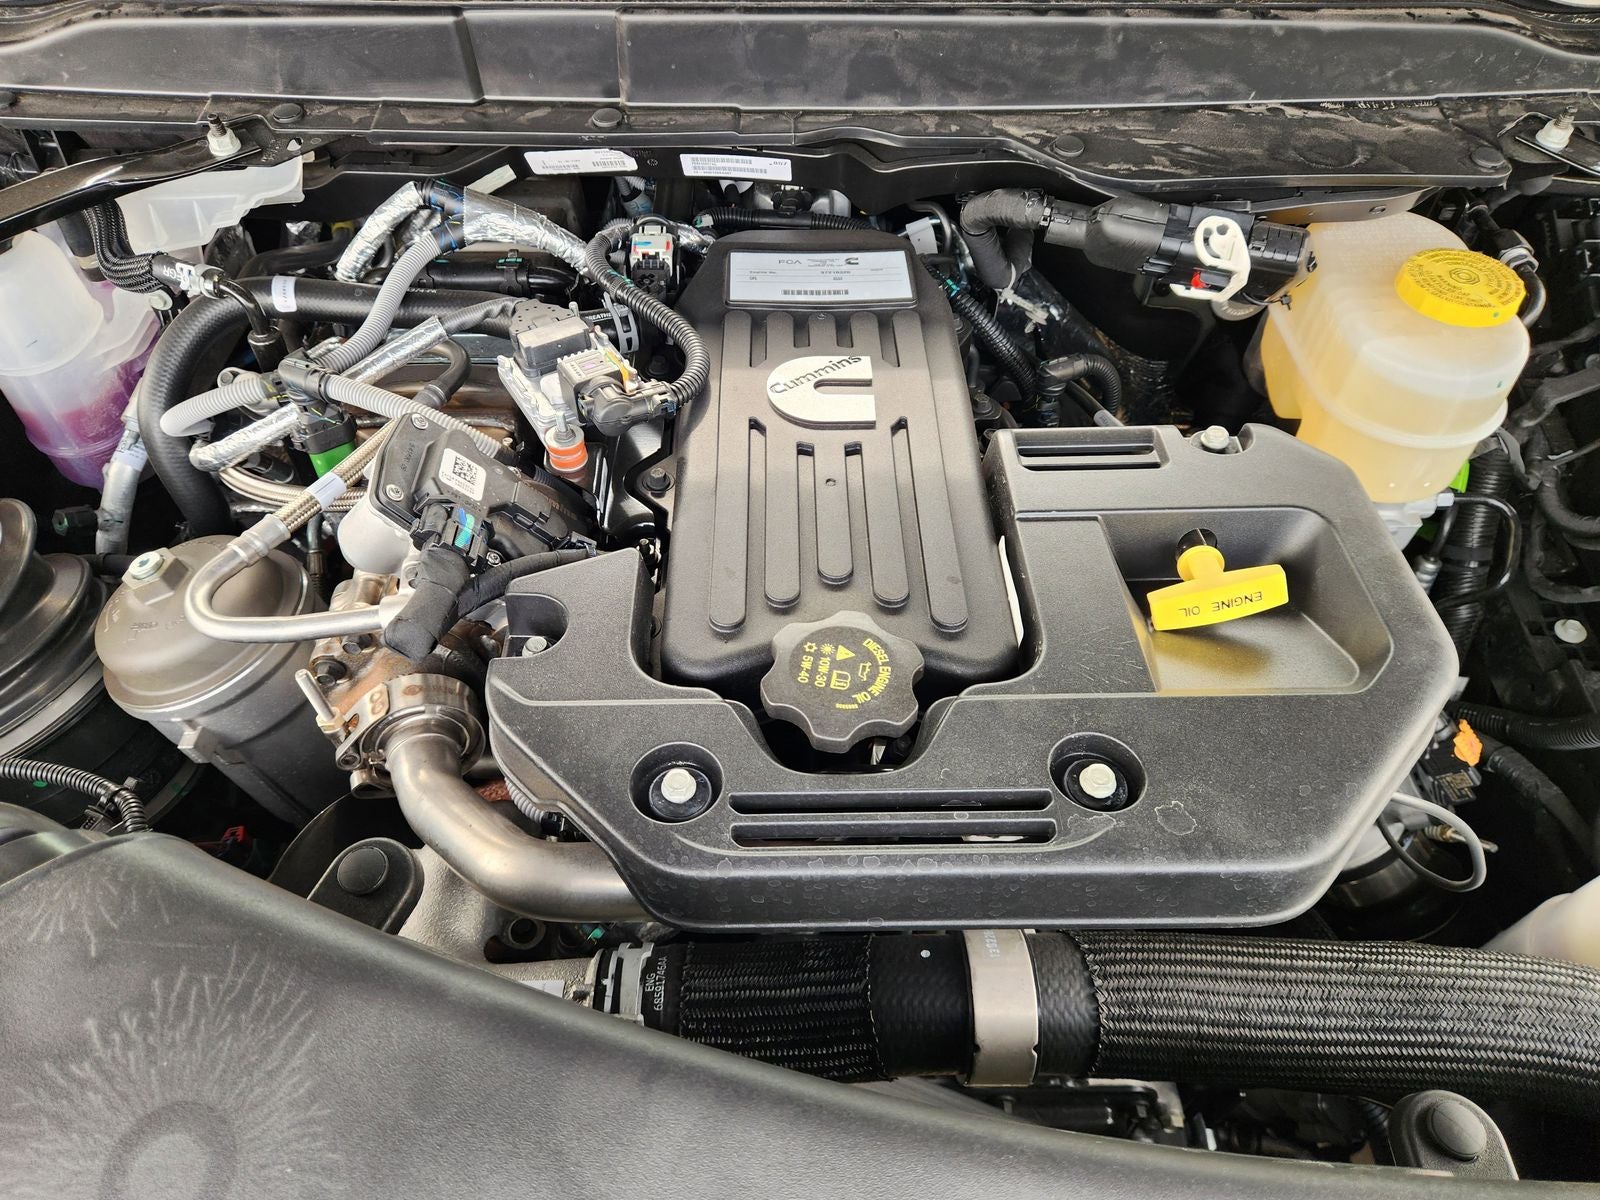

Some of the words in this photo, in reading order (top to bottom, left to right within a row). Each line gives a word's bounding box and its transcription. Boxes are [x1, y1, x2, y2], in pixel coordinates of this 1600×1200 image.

[162, 265, 183, 281] EGR
[769, 354, 862, 394] Cummins
[1178, 605, 1201, 617] OIL
[1211, 591, 1263, 612] ENGINE
[863, 638, 889, 665] DIESEL
[797, 655, 814, 683] 5W-40
[815, 656, 831, 688] 10W-30
[867, 666, 891, 697] ENGINE
[852, 691, 872, 704] OIL
[644, 973, 656, 991] ENG
